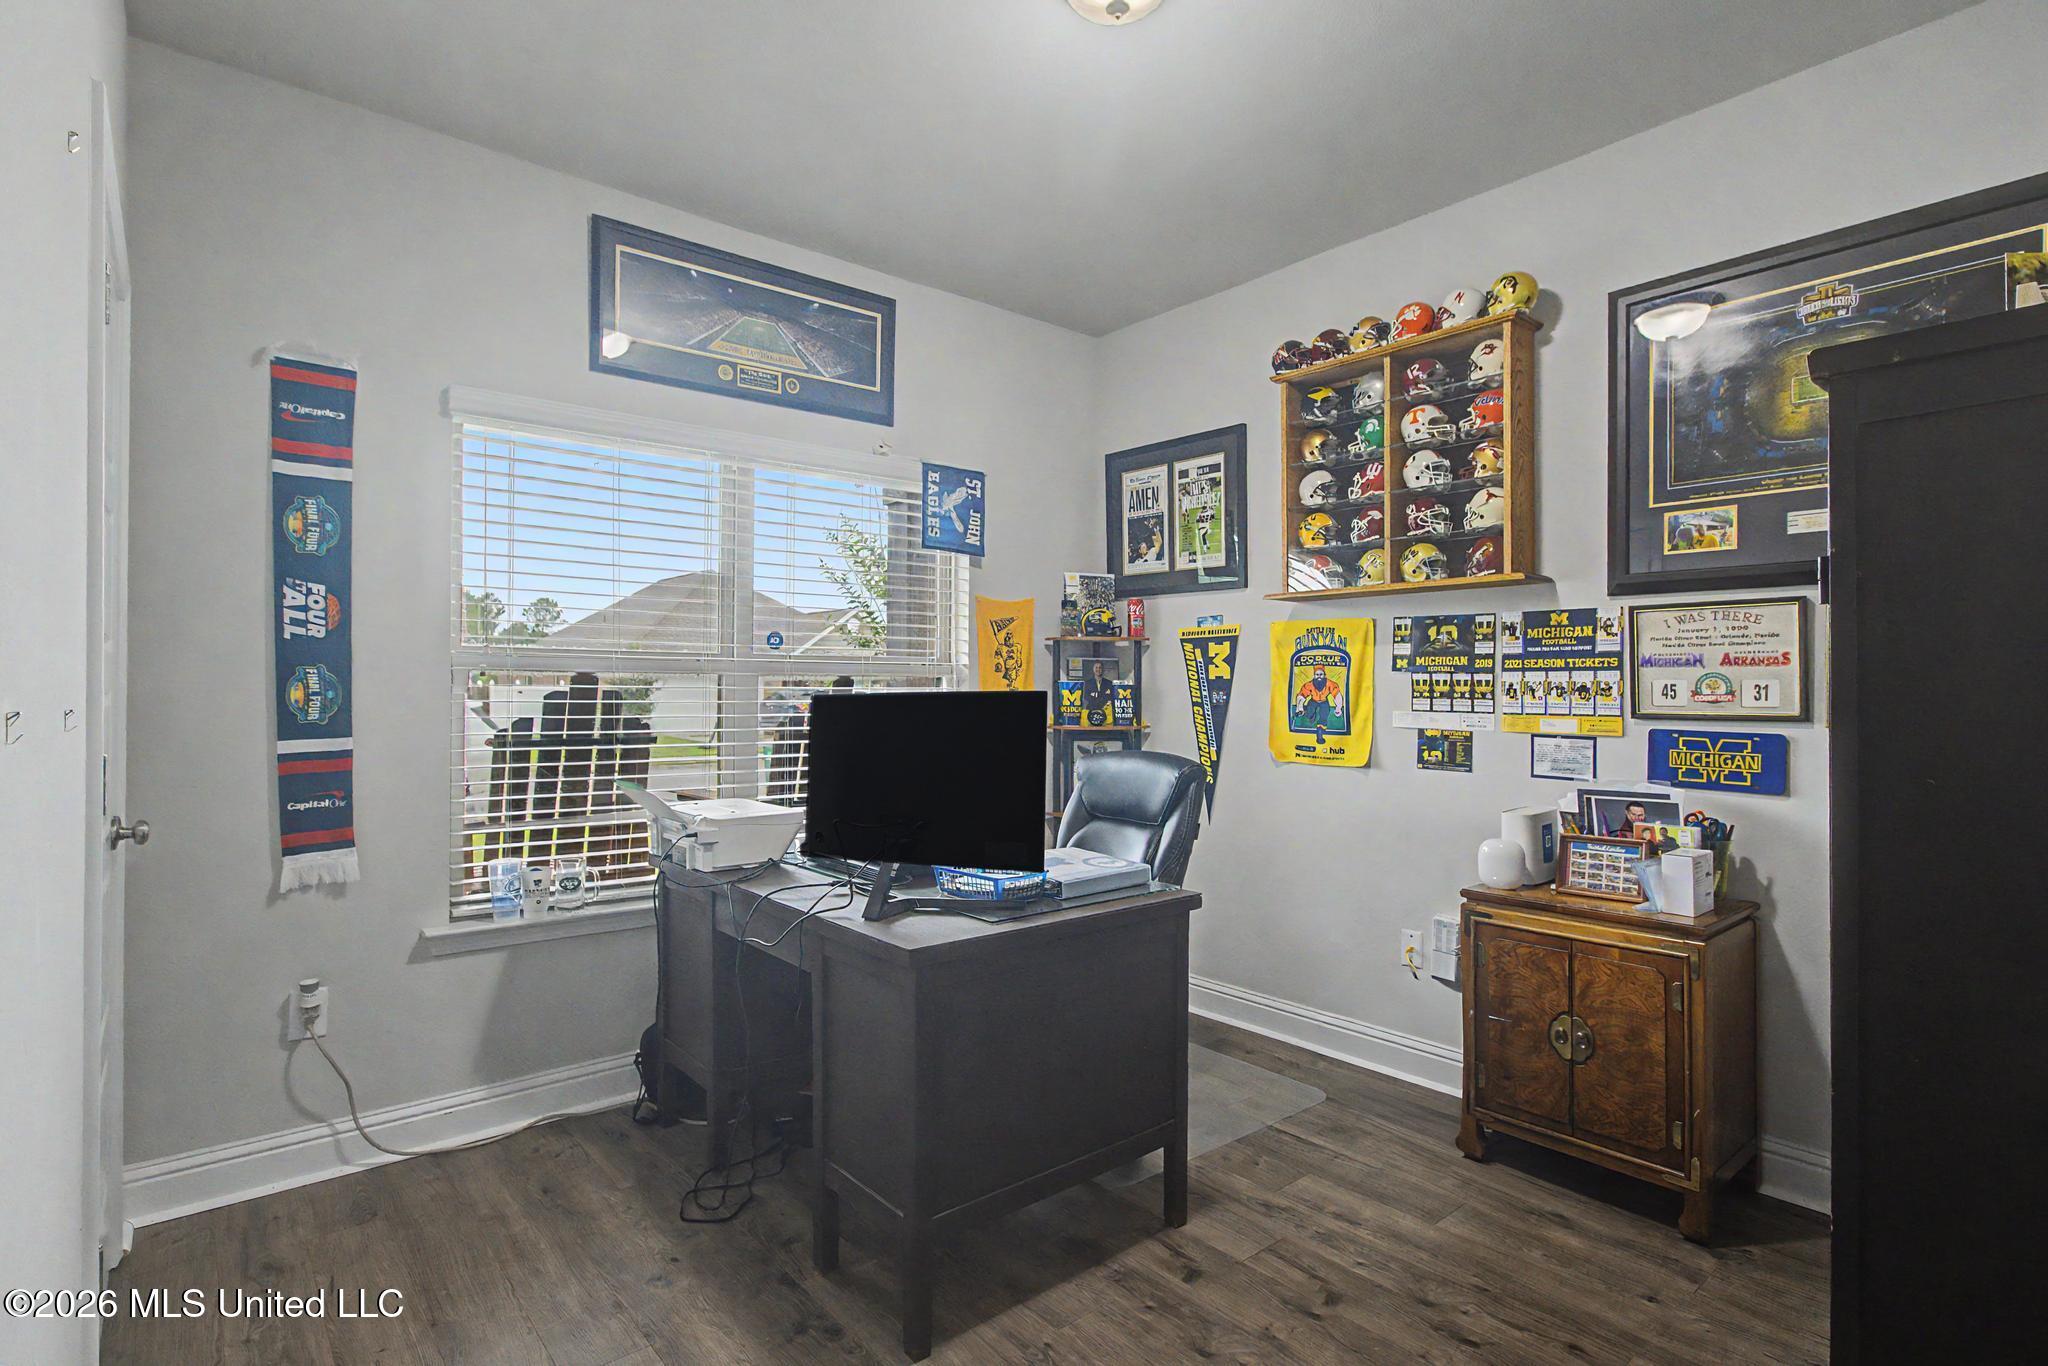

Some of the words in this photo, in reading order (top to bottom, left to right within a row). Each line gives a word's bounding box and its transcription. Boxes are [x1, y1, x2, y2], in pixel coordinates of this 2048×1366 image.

[927, 470, 940, 538] EAGLES
[965, 509, 981, 546] JOHN
[305, 526, 321, 551] FOUR
[282, 584, 307, 640] ALL
[306, 581, 326, 638] FOUR
[1673, 611, 1706, 625] WAS
[1710, 610, 1764, 625] THERE
[1550, 612, 1569, 626] M
[1527, 625, 1593, 639] MICHIGAN
[1209, 641, 1231, 680] M
[1415, 656, 1469, 666] MICHIGAN
[1474, 659, 1493, 668] 2019
[1524, 658, 1565, 668] SEASON
[1567, 658, 1619, 668] TICKETS
[1719, 651, 1792, 667] ARKANSAS
[1183, 642, 1202, 702] NATIONAL
[1061, 689, 1082, 706] M
[1117, 688, 1132, 699] M
[1661, 683, 1677, 700] 45
[1753, 684, 1769, 701] 31
[307, 696, 320, 720] FOUR
[1115, 699, 1133, 708] HAIL
[1329, 747, 1345, 755] hub
[1672, 751, 1759, 770] MICHIGAN
